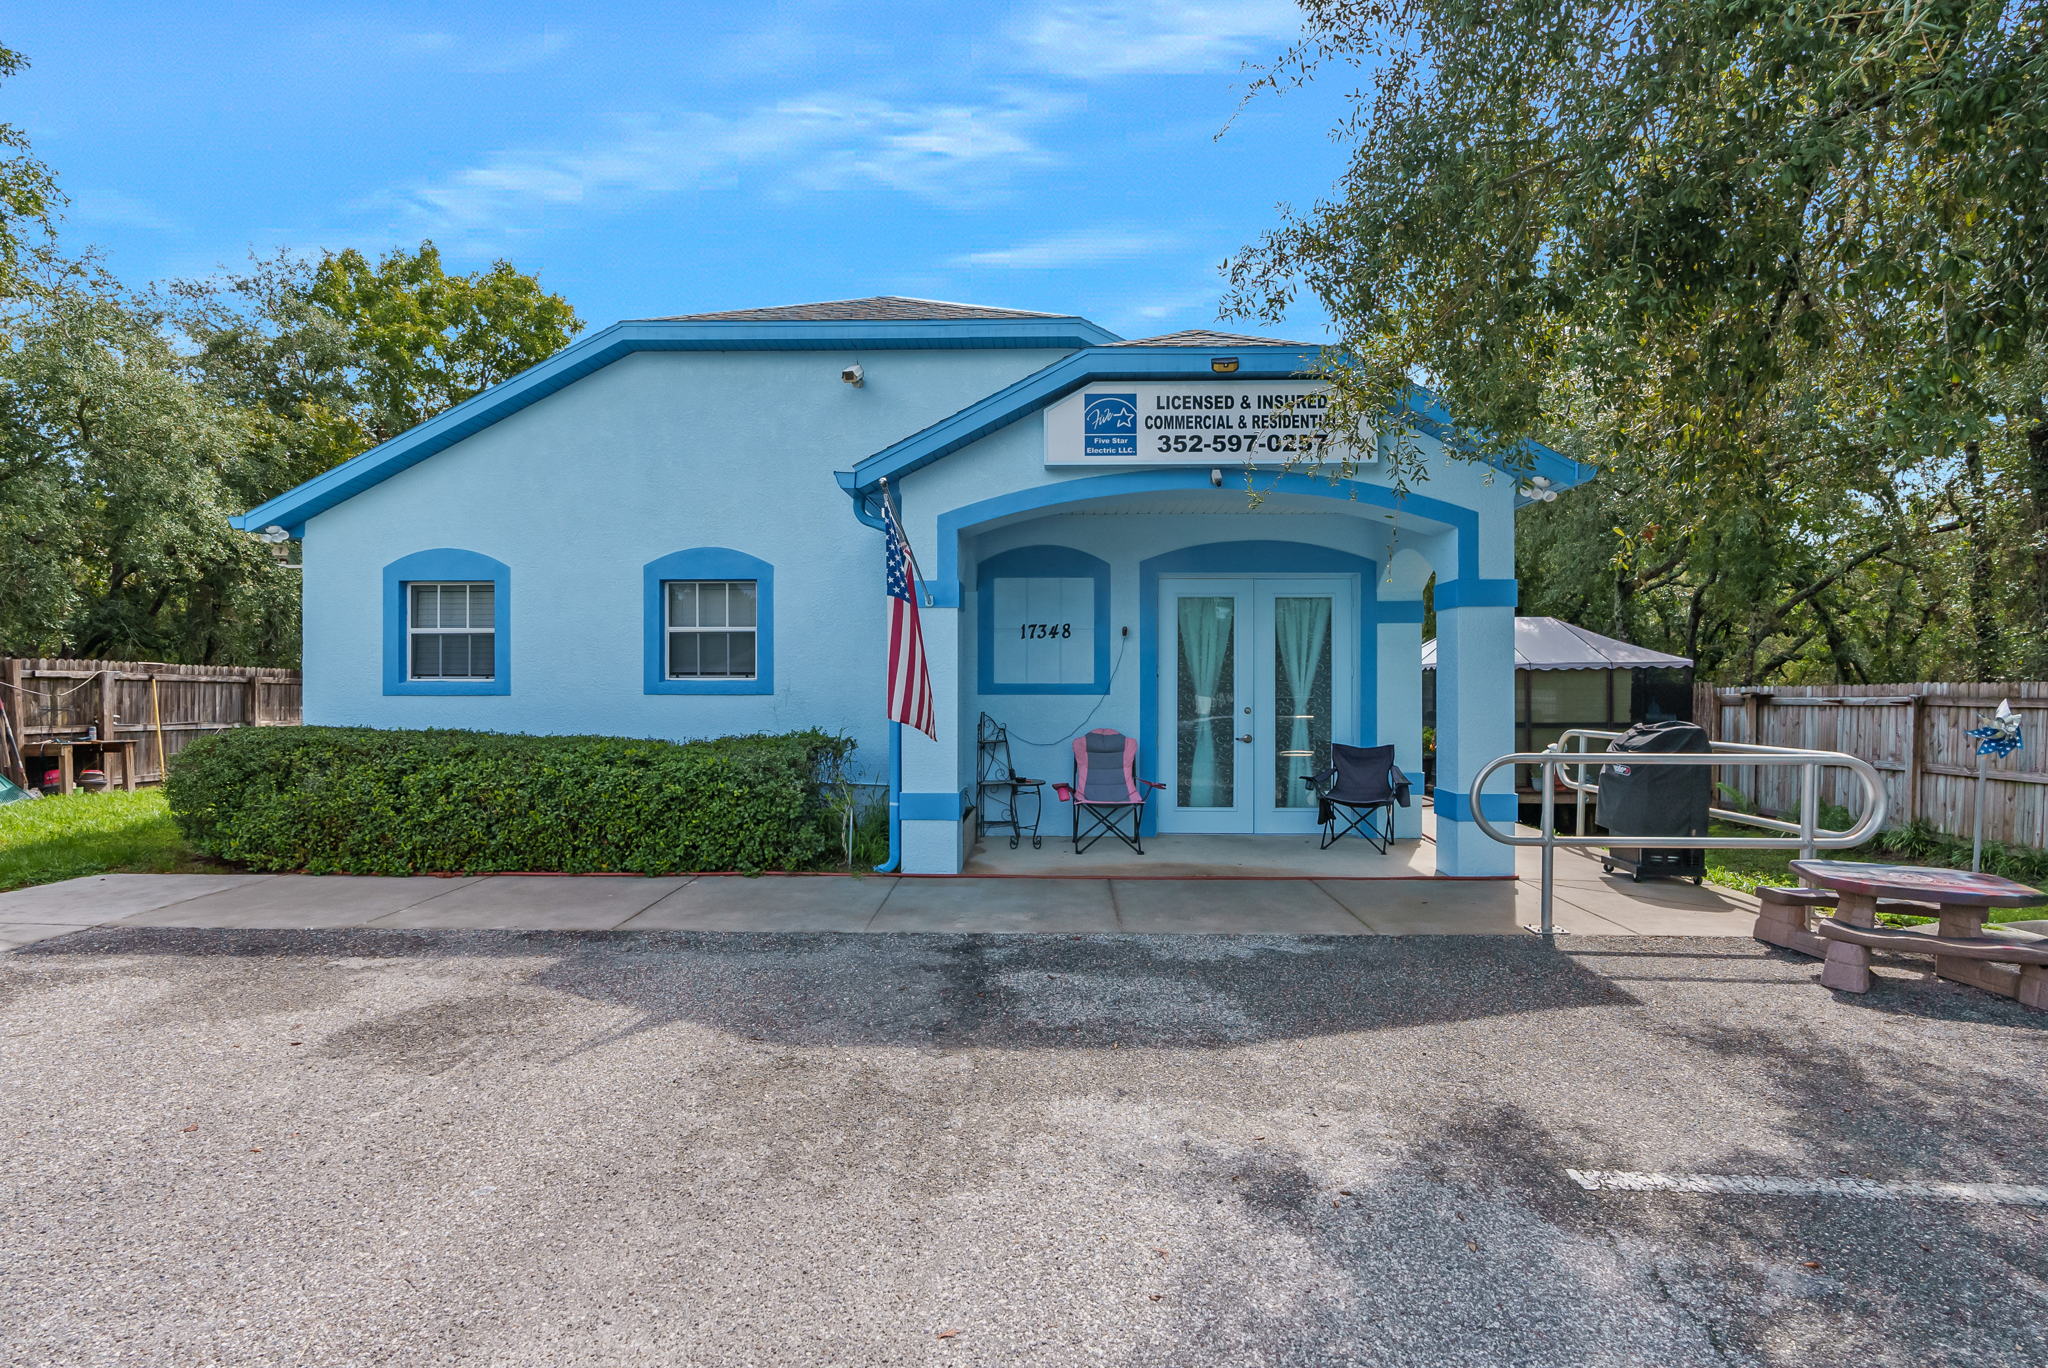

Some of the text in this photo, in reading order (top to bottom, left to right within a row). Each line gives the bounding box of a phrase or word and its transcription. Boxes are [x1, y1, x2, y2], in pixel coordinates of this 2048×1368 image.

[1156, 394, 1328, 410] LICENSED & INSURED
[1144, 414, 1339, 430] COMMERCIAL & RESIDENTI
[1021, 623, 1071, 639] 17348
